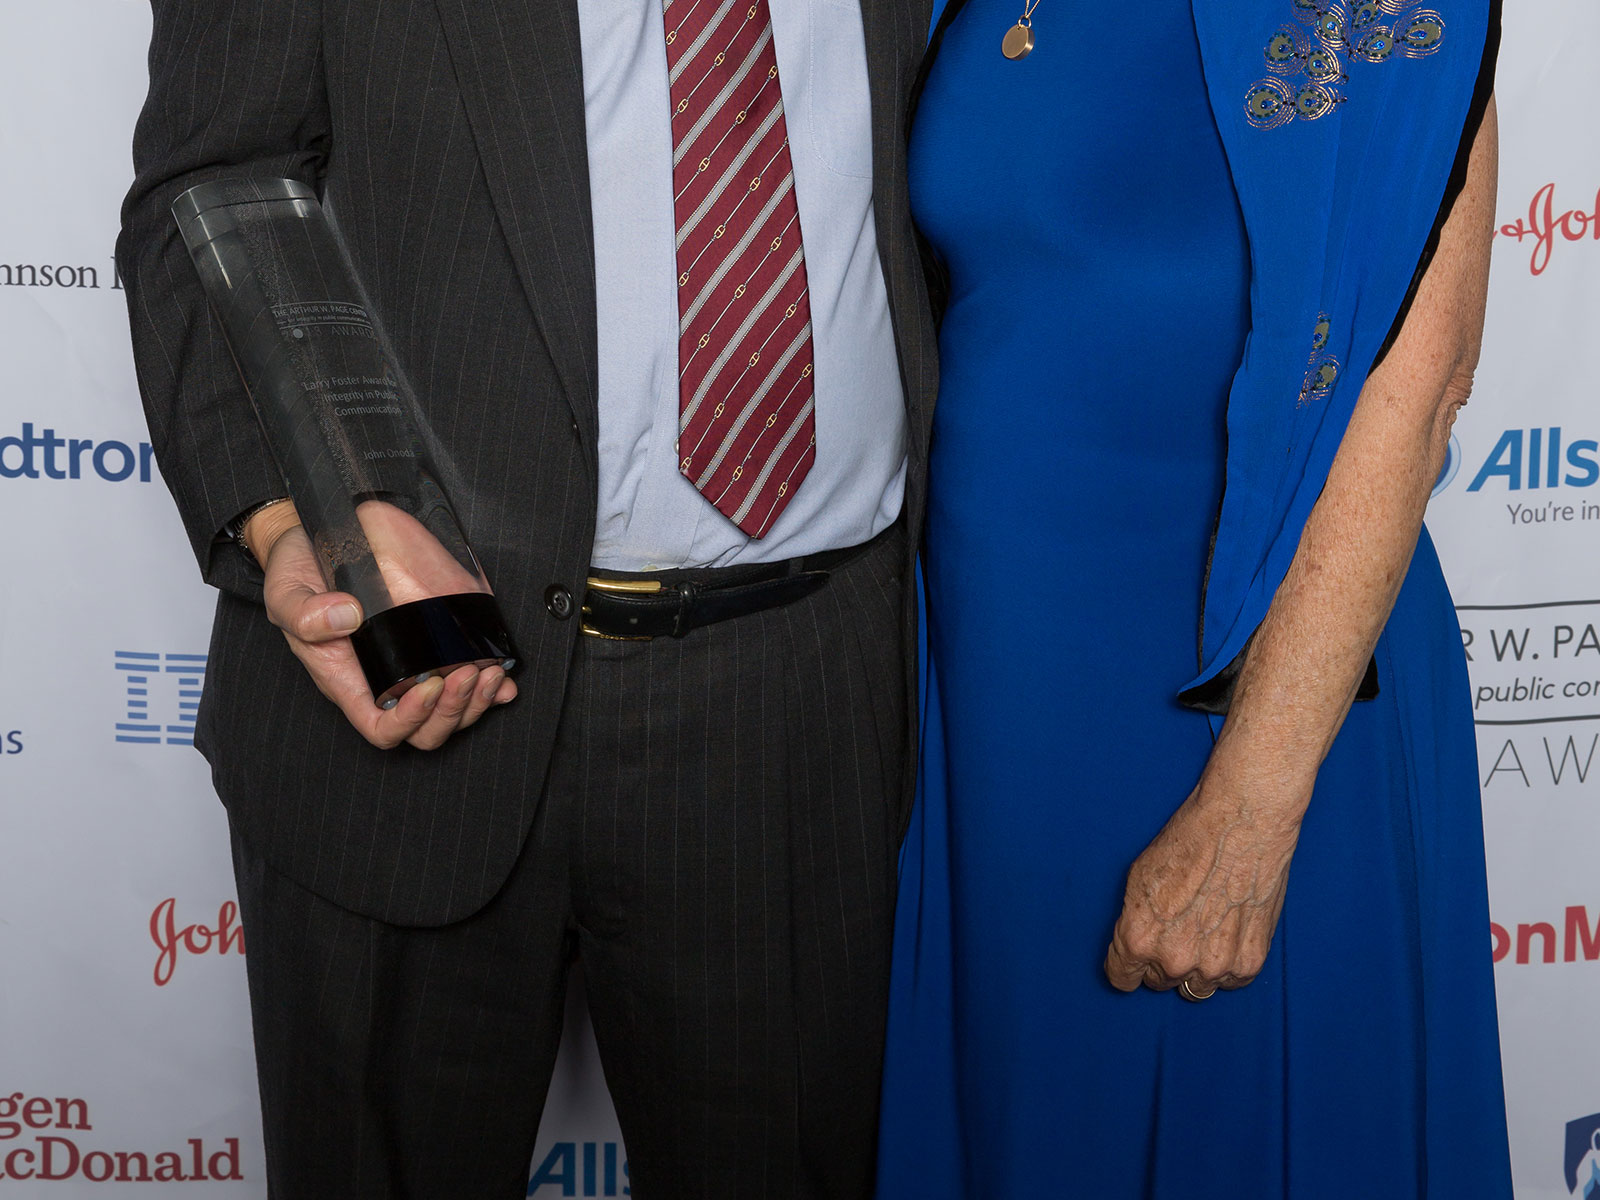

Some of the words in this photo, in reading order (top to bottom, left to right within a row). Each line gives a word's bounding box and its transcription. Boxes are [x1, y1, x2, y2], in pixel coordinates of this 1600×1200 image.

[324, 390, 364, 403] Integrity
[331, 376, 360, 387] Foster
[363, 448, 386, 461] John
[1466, 426, 1600, 492] Alls
[1507, 500, 1574, 526] You're
[1490, 628, 1540, 662] W.
[1475, 676, 1555, 710] public
[0, 730, 24, 755] s
[1484, 732, 1599, 788] AW
[0, 1136, 244, 1182] cDonald
[527, 1142, 632, 1197] All
